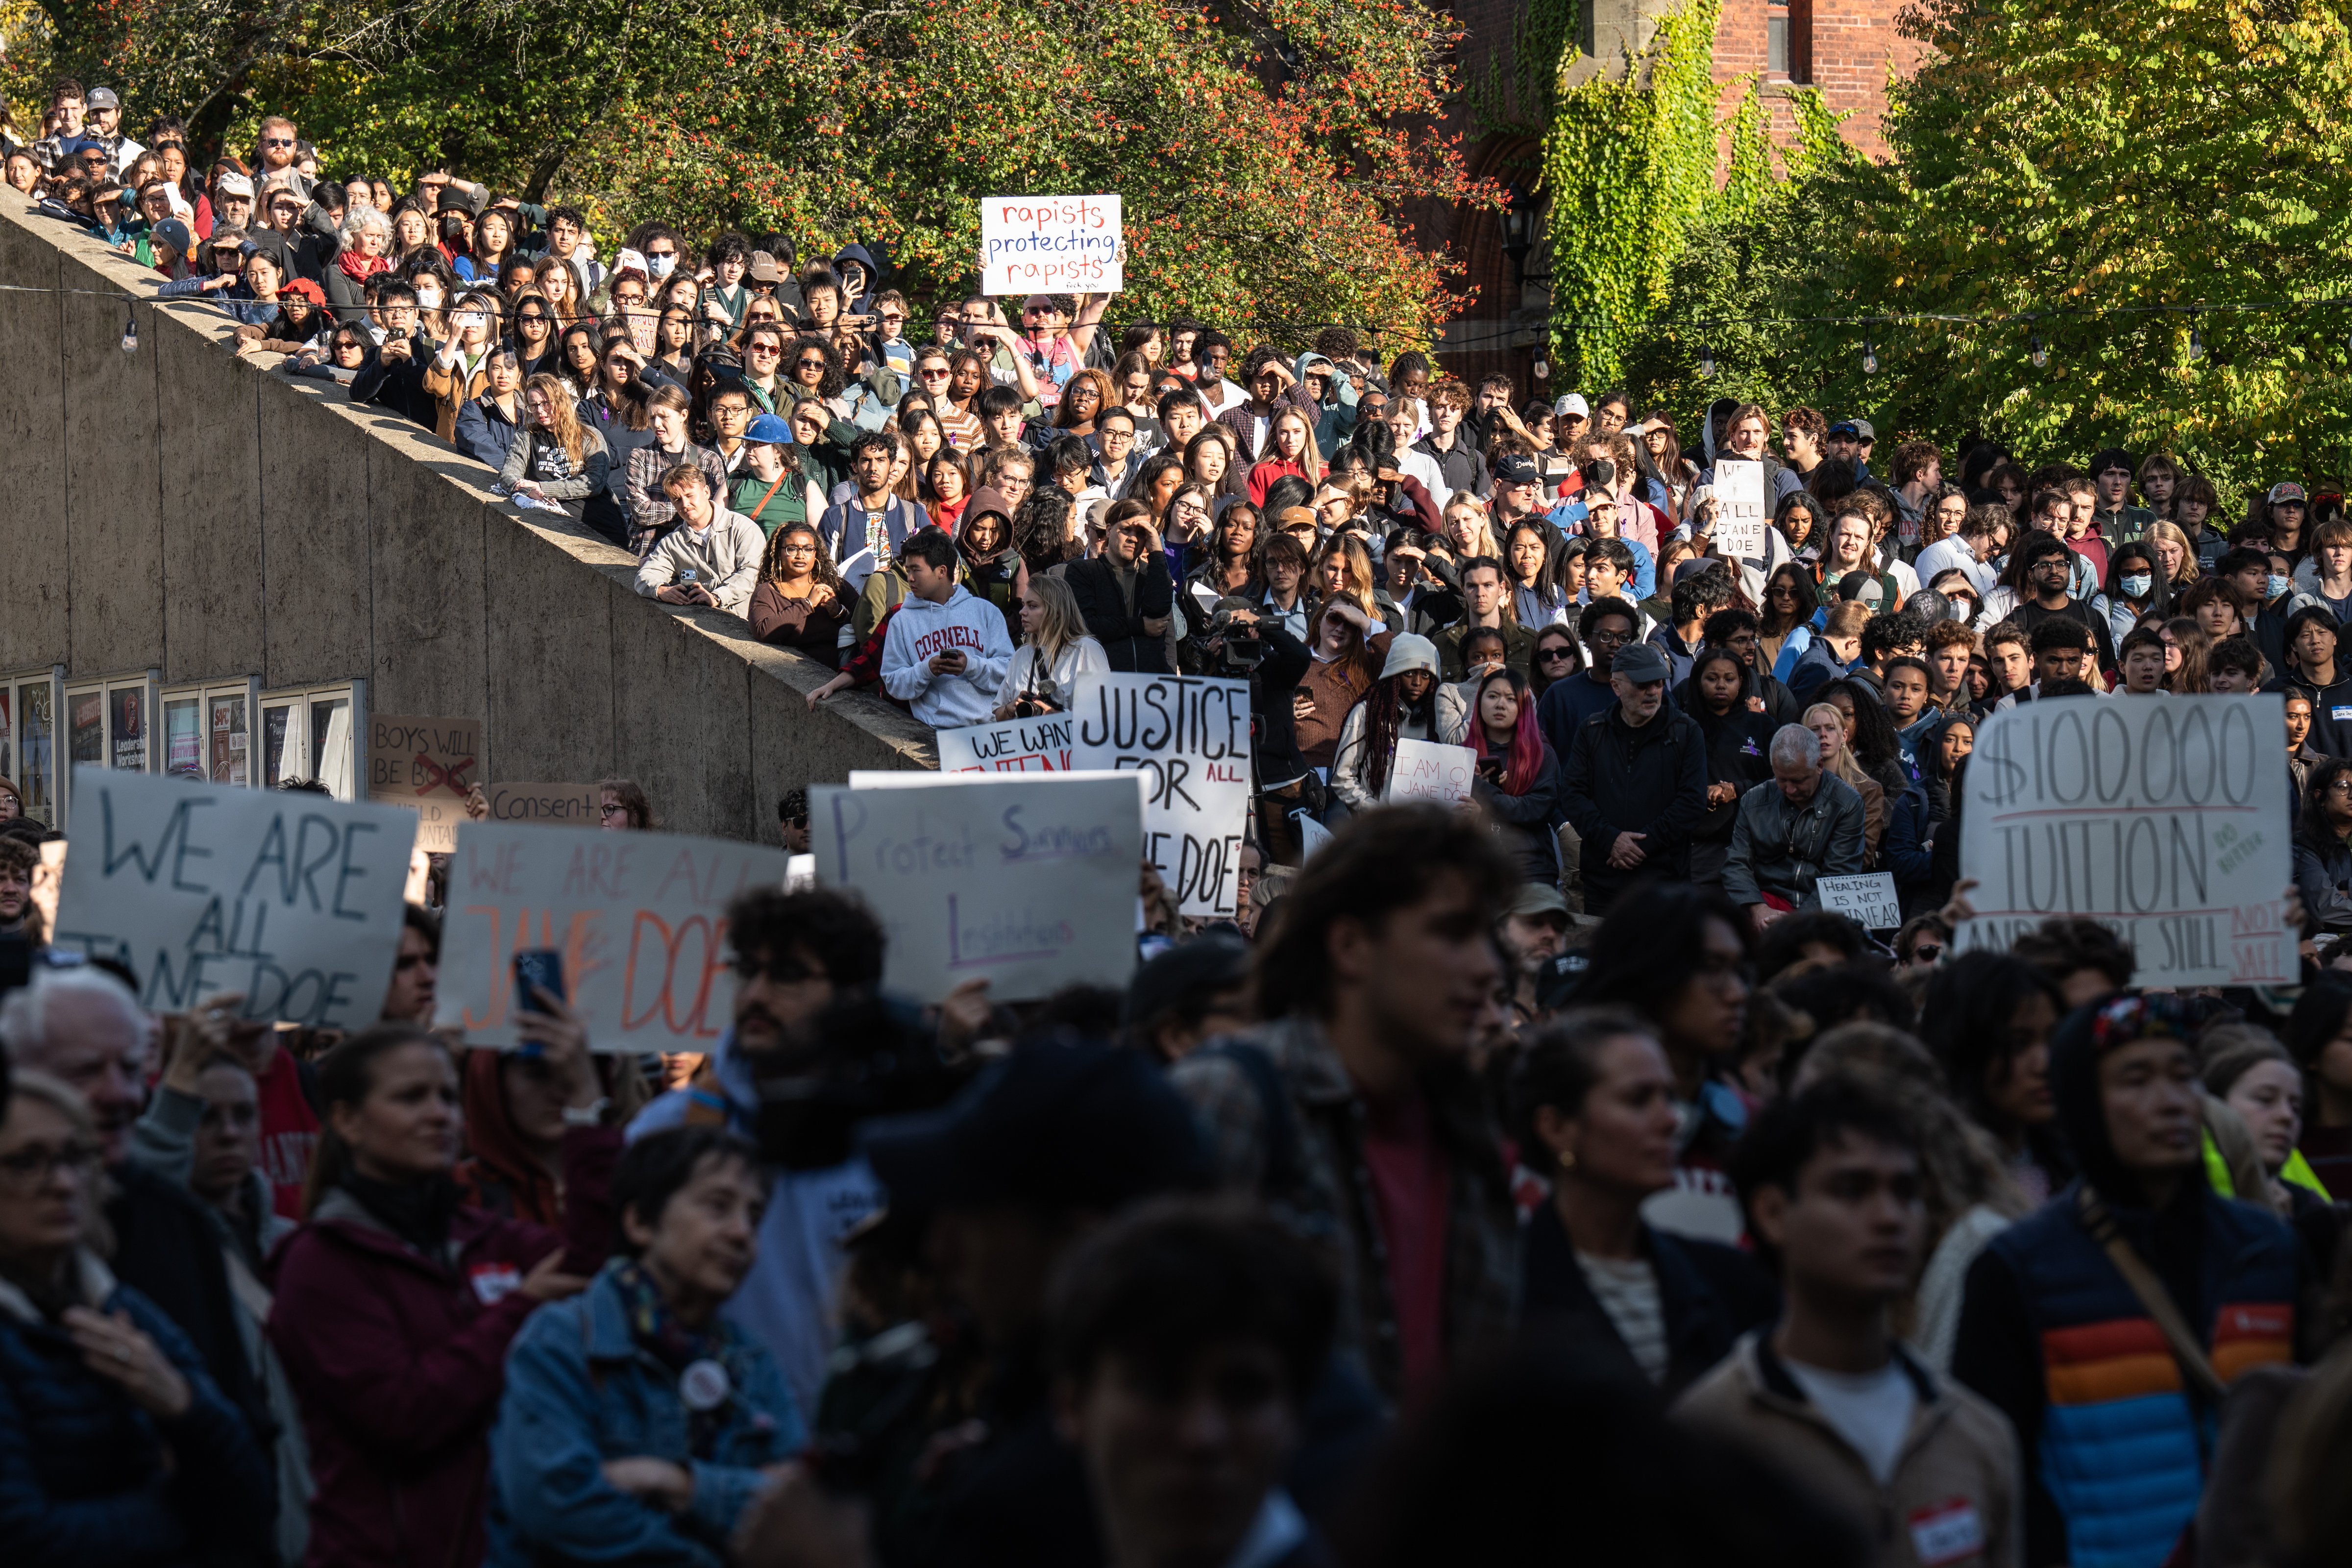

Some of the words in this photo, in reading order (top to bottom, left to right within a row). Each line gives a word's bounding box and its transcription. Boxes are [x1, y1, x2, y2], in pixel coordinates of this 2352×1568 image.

[1003, 199, 1104, 231] rapists
[990, 229, 1114, 263] protecting
[1007, 255, 1103, 285] rapists
[1720, 503, 1758, 519] ALL
[1719, 523, 1761, 535] JANE
[1728, 538, 1753, 551] DOE
[915, 626, 984, 662] CORNELL
[1081, 676, 1248, 760] JUSTICE
[117, 736, 145, 753] Leadershi
[200, 739, 204, 750] 10
[246, 735, 249, 745] 11
[302, 748, 306, 759] 12
[375, 722, 429, 754] BOYS
[434, 728, 474, 756] WILL
[972, 730, 1015, 759] WE
[1393, 756, 1410, 775] I
[1414, 759, 1439, 780] AM
[1978, 702, 2255, 809] $100,000
[374, 758, 403, 784] BE
[412, 760, 467, 788] BOYS
[1207, 762, 1243, 782] ALL
[1401, 780, 1440, 799] JANE
[493, 790, 594, 820] Consent
[100, 787, 218, 893] WE
[243, 810, 379, 922] ARE
[1995, 810, 2207, 915] TUITION
[467, 840, 524, 897] WE
[564, 842, 637, 901] ARE
[1177, 833, 1241, 912] DOE
[1823, 880, 1881, 891] HEALING
[1832, 896, 1849, 906] IS
[1857, 892, 1882, 903] NOT
[187, 893, 275, 961] ALL
[1845, 903, 1901, 927] INEAR
[2158, 916, 2229, 974] STILL
[620, 909, 734, 1039] DOE
[245, 962, 358, 1028] DOE
